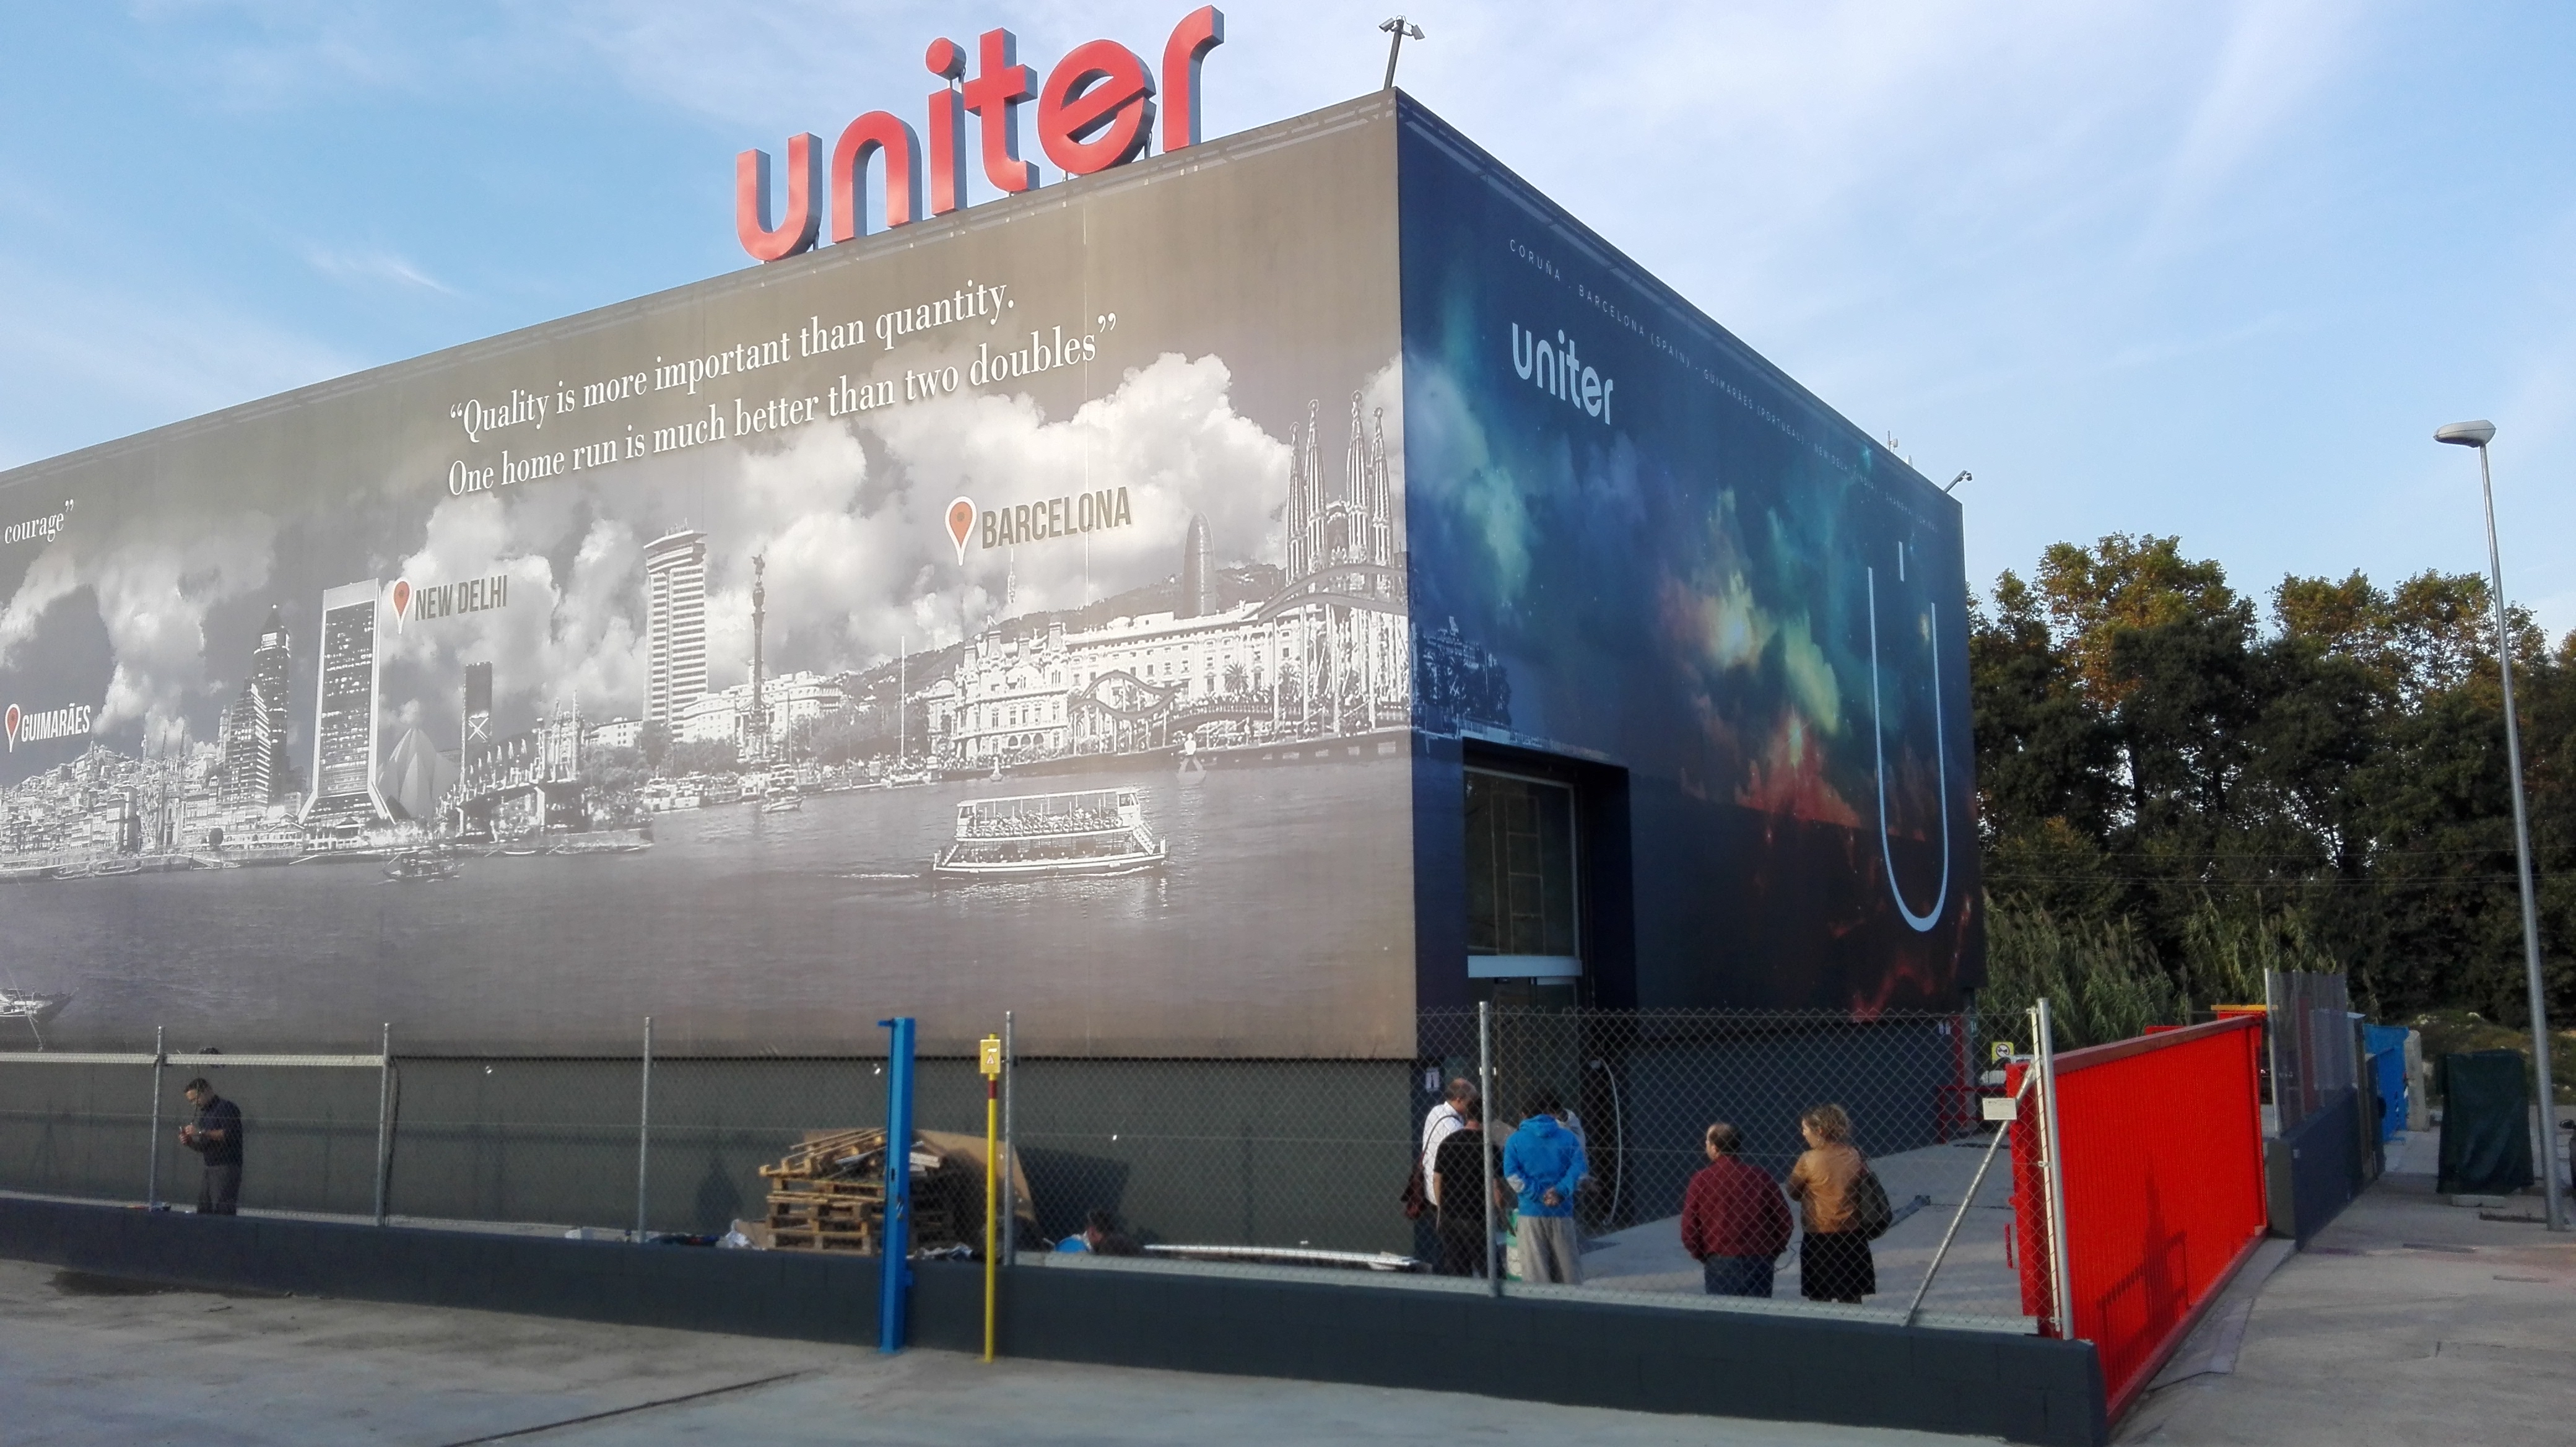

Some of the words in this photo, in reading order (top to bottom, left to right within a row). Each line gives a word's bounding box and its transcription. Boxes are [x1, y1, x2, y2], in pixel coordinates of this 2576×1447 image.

[736, 4, 1225, 261] uniter
[1510, 239, 1560, 281] CORUÑA
[1579, 284, 1645, 337] BARCELONA
[1650, 333, 1690, 368] (SPAIN)
[448, 460, 494, 496] One
[500, 450, 565, 486] home
[572, 437, 619, 471] run
[625, 424, 645, 460] is
[653, 403, 726, 453] much
[734, 397, 819, 437] better
[827, 375, 895, 417] than
[905, 365, 959, 401] two
[970, 312, 1117, 387] doubles”
[450, 389, 550, 443] “Quality
[556, 380, 576, 414] is
[583, 371, 648, 408] more
[655, 331, 791, 395] important
[800, 315, 866, 358] than
[876, 279, 1015, 351] quantity.
[1512, 322, 1614, 426] uniter
[4, 499, 74, 544] courage”
[982, 486, 1131, 549] BARCELONA
[415, 584, 453, 621] NEW
[457, 575, 508, 614] DELHI
[21, 703, 91, 743] GUIMARÃES
